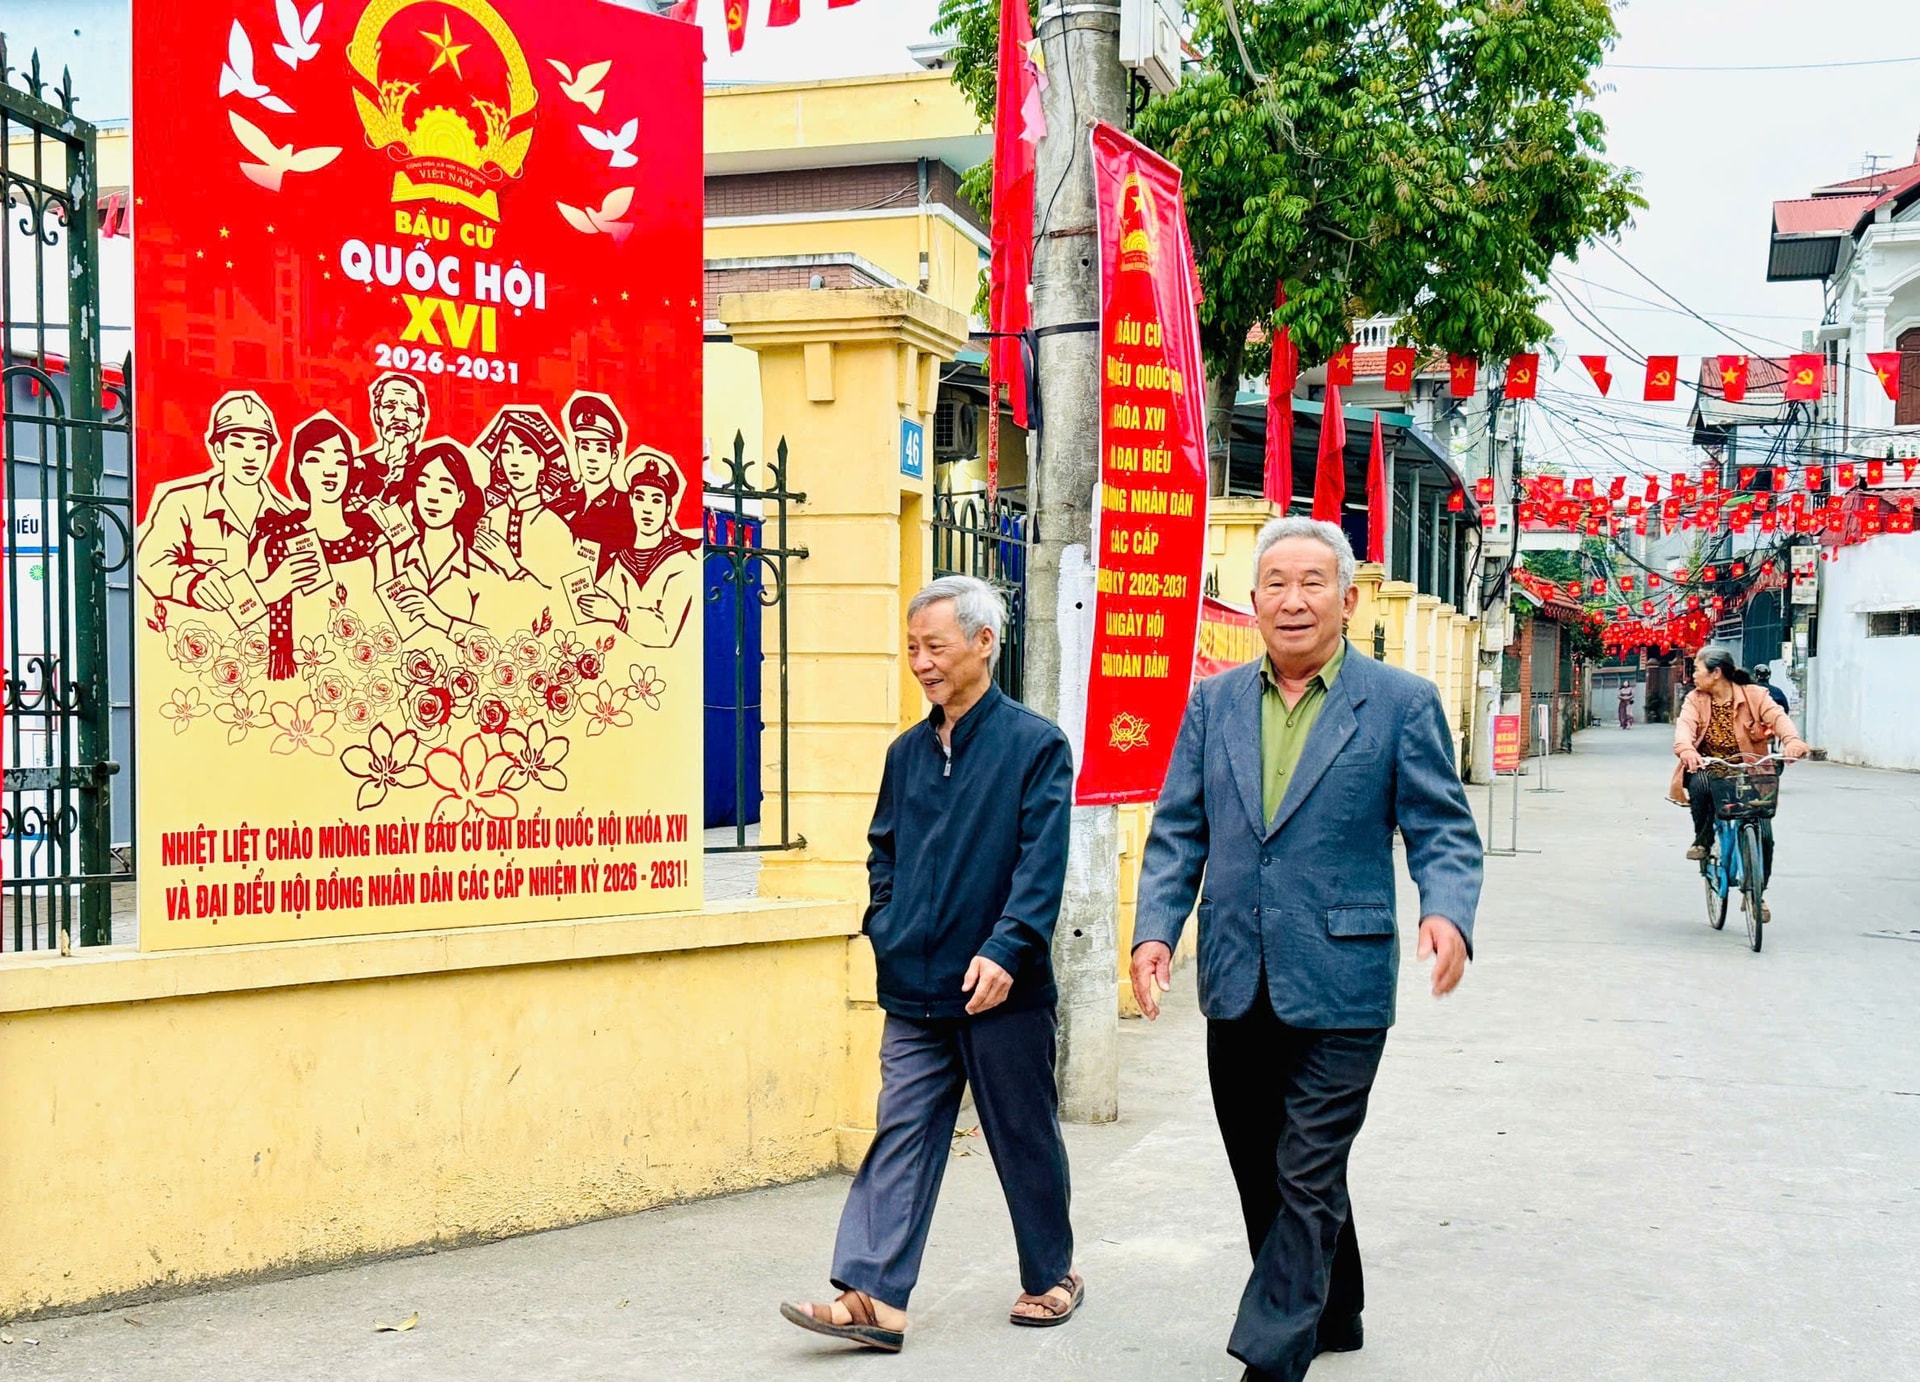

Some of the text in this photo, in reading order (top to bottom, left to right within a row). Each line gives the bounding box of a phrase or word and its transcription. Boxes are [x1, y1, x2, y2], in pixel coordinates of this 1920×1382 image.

[419, 168, 474, 189] VIỆT NAM
[395, 206, 497, 249] BẦU CỬ
[340, 239, 546, 317] QUỐC HỘI
[400, 293, 498, 353] XVI
[374, 343, 519, 384] 2026-2031
[1136, 358, 1171, 391] QUỐC
[1144, 406, 1166, 431] XVI
[905, 429, 919, 466] 46
[1142, 440, 1172, 474] BIỂU
[1131, 486, 1168, 515] NHÂN
[1169, 489, 1194, 517] DÂN
[1133, 523, 1159, 555] CẤP
[1128, 572, 1187, 598] 2026-2031
[1146, 608, 1165, 643] HỘI
[1144, 650, 1169, 678] DÂN!
[162, 823, 217, 872] NHIỆT
[223, 821, 260, 869] LIỆT
[265, 820, 313, 861] CHÀO
[319, 817, 370, 859] MỪNG
[375, 816, 420, 856] NGÀY
[424, 811, 456, 853] BẦU
[487, 818, 512, 857] ĐẠI
[517, 806, 551, 849] BIỂU
[555, 806, 594, 850] QUỐC
[598, 810, 622, 852] HỘI
[625, 809, 662, 845] KHÓA
[666, 814, 688, 842] XVI
[165, 879, 191, 921] VÀ
[196, 884, 228, 925] ĐẠI
[233, 867, 275, 916] BIỂU
[280, 872, 311, 919] HỘI
[315, 867, 364, 911] ĐỒNG
[368, 867, 416, 907] NHÂN
[420, 865, 453, 903] DÂN
[458, 863, 489, 901] CÁC
[493, 857, 524, 899] CẤP
[528, 859, 577, 901] NHIỆM
[580, 858, 600, 893] KỲ
[603, 862, 637, 892] 2026
[650, 859, 688, 890] 2031!
